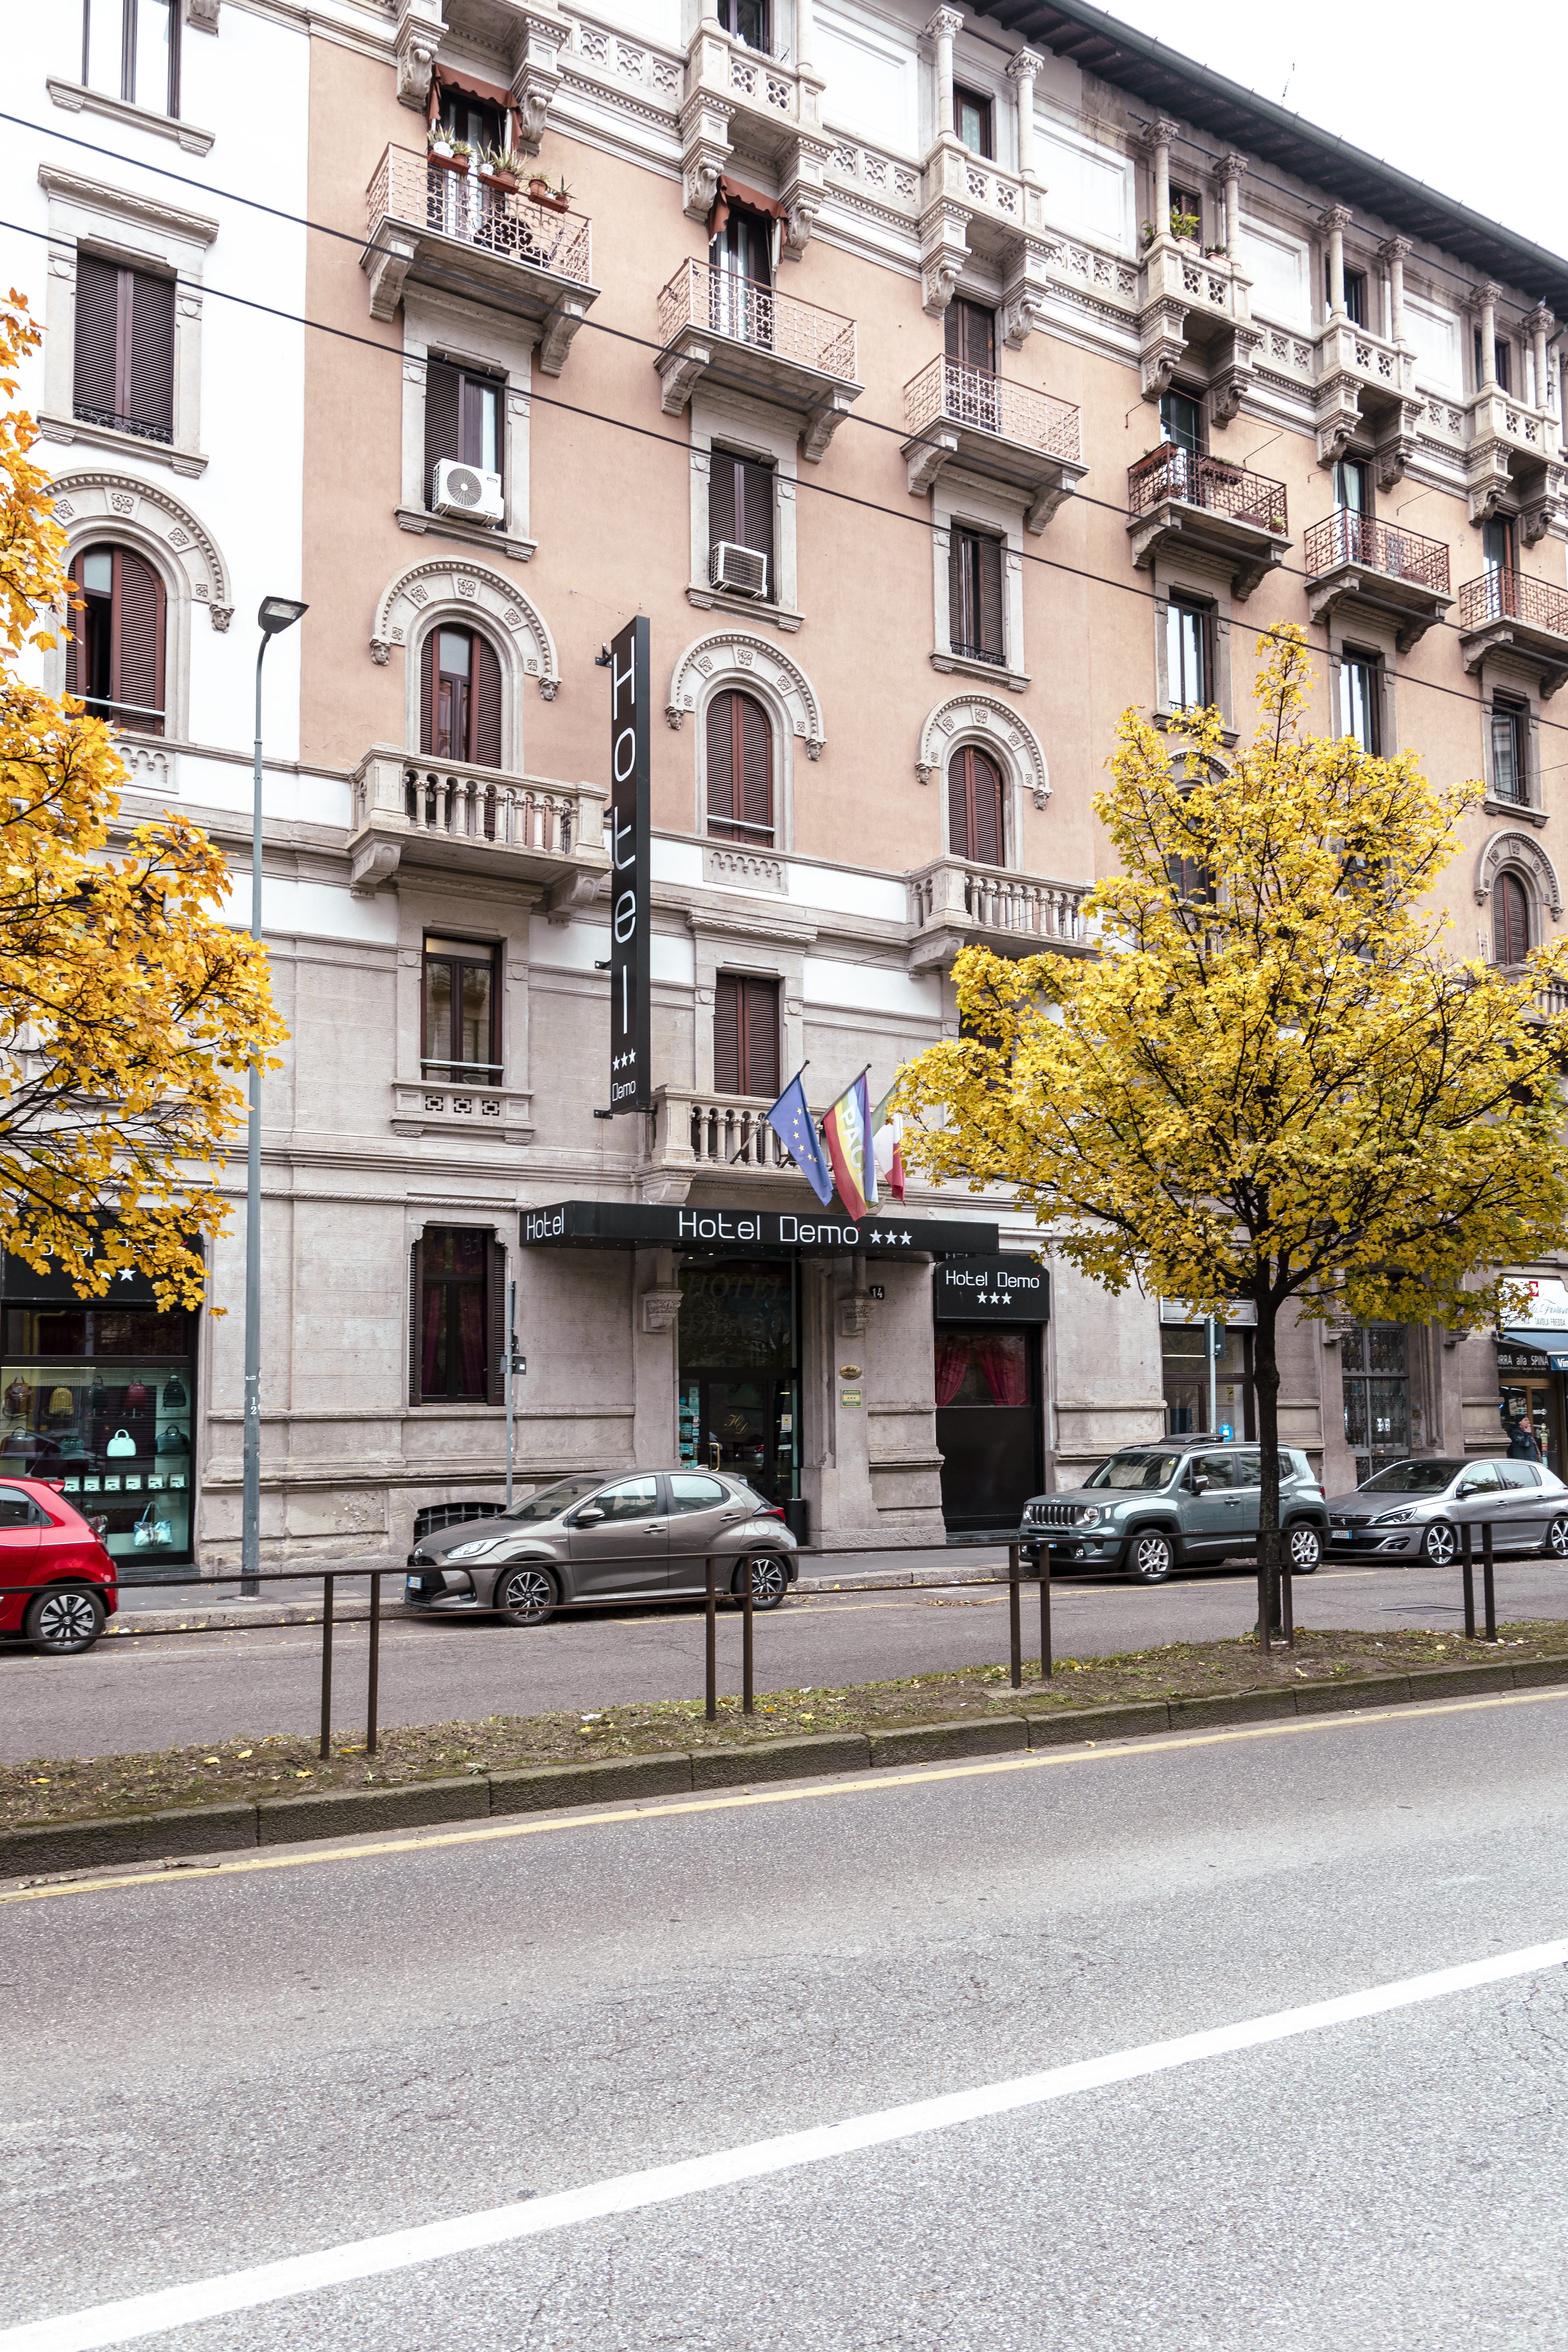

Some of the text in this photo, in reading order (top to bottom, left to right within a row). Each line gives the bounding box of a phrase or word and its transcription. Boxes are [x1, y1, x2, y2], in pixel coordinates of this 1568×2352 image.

[613, 635, 636, 1034] Hotel
[527, 1207, 564, 1240] Hotel
[679, 1211, 760, 1240] Hotel
[684, 1274, 788, 1300] HOTEL
[946, 1270, 988, 1286] Hotel
[872, 1288, 883, 1298] 14
